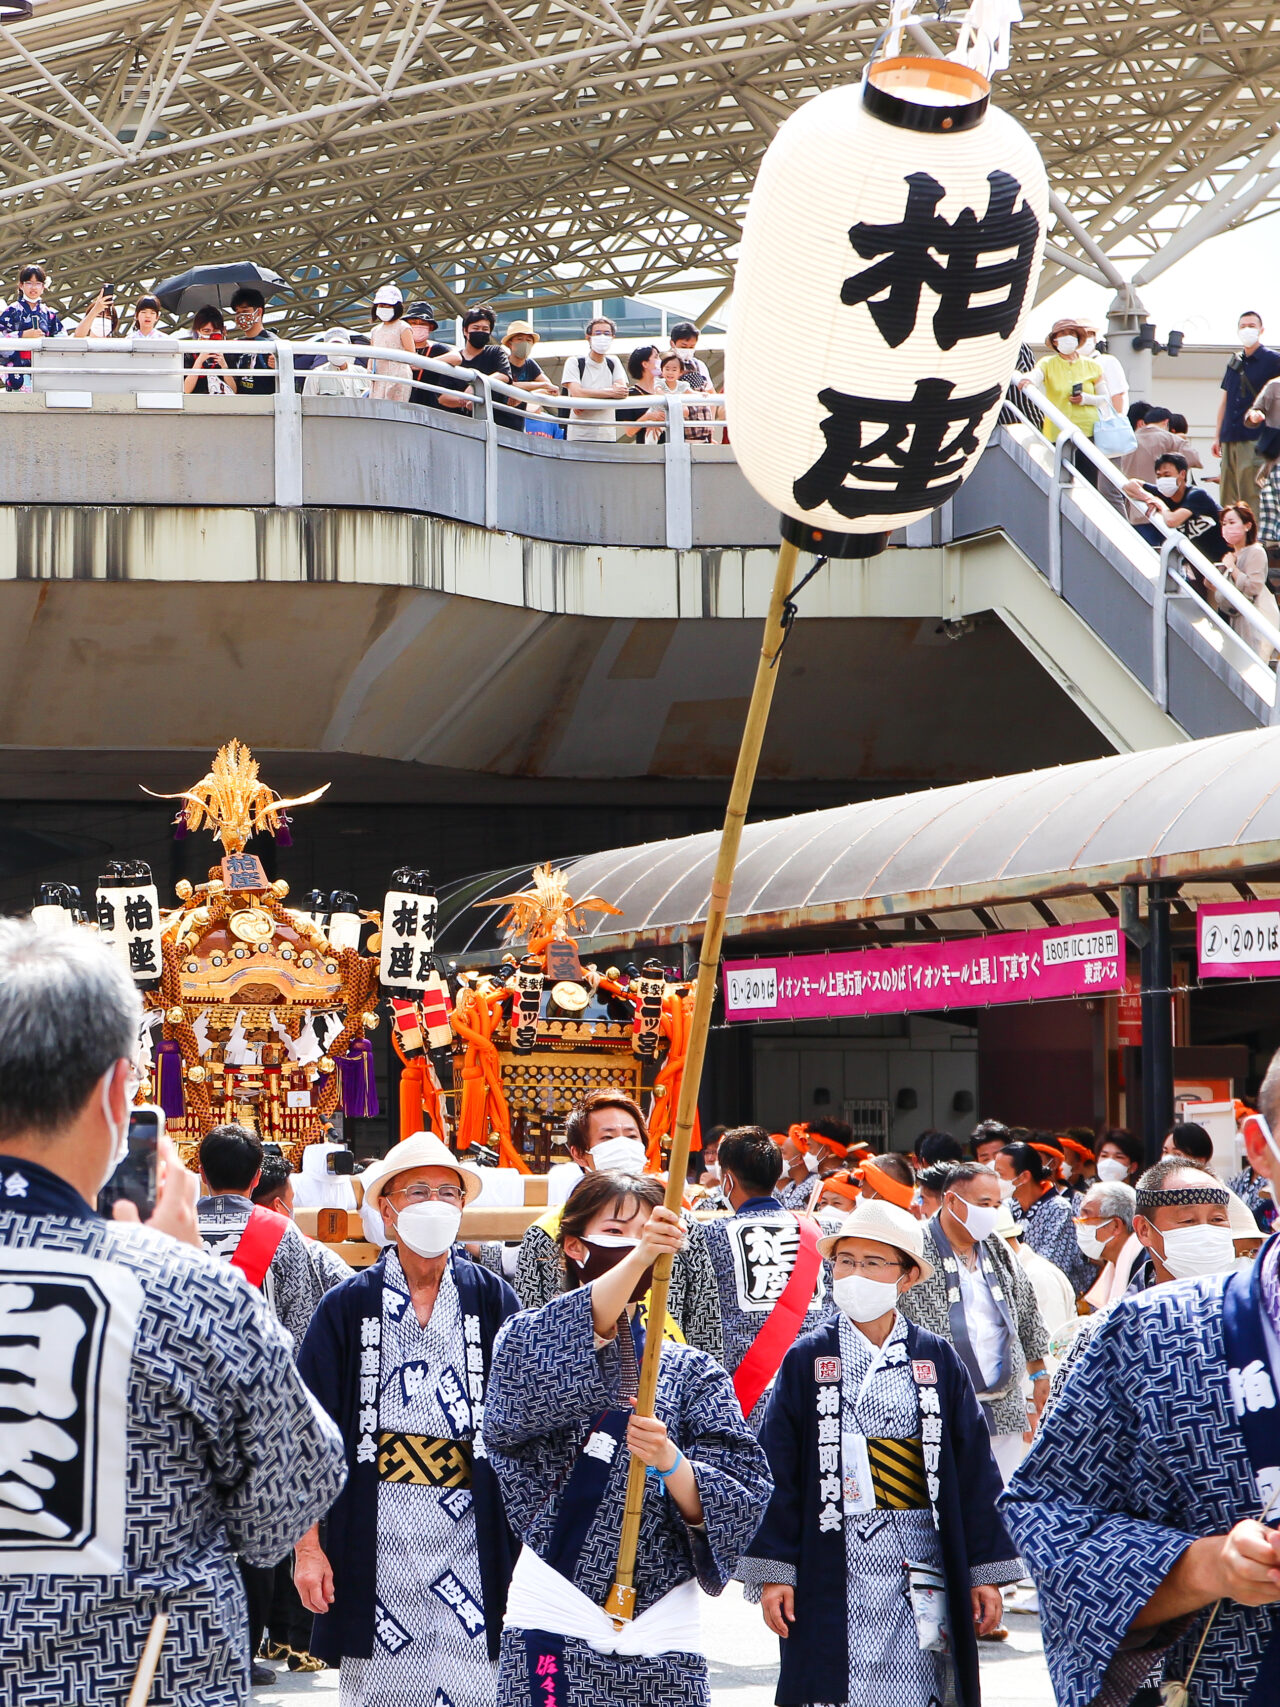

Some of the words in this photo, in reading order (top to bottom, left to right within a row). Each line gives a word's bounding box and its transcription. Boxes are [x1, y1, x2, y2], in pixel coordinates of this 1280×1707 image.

[793, 169, 1039, 519] 柏座
[227, 854, 262, 888] 柏座
[124, 894, 157, 973] 柏座
[1084, 961, 1118, 985] 東武バス
[516, 990, 540, 1047] 二ツ宮
[638, 996, 662, 1054] 二ツ宮
[356, 1316, 381, 1464] 柏座町内会
[464, 1313, 488, 1460] 柏座町内会
[816, 1385, 842, 1533] 柏座町内会
